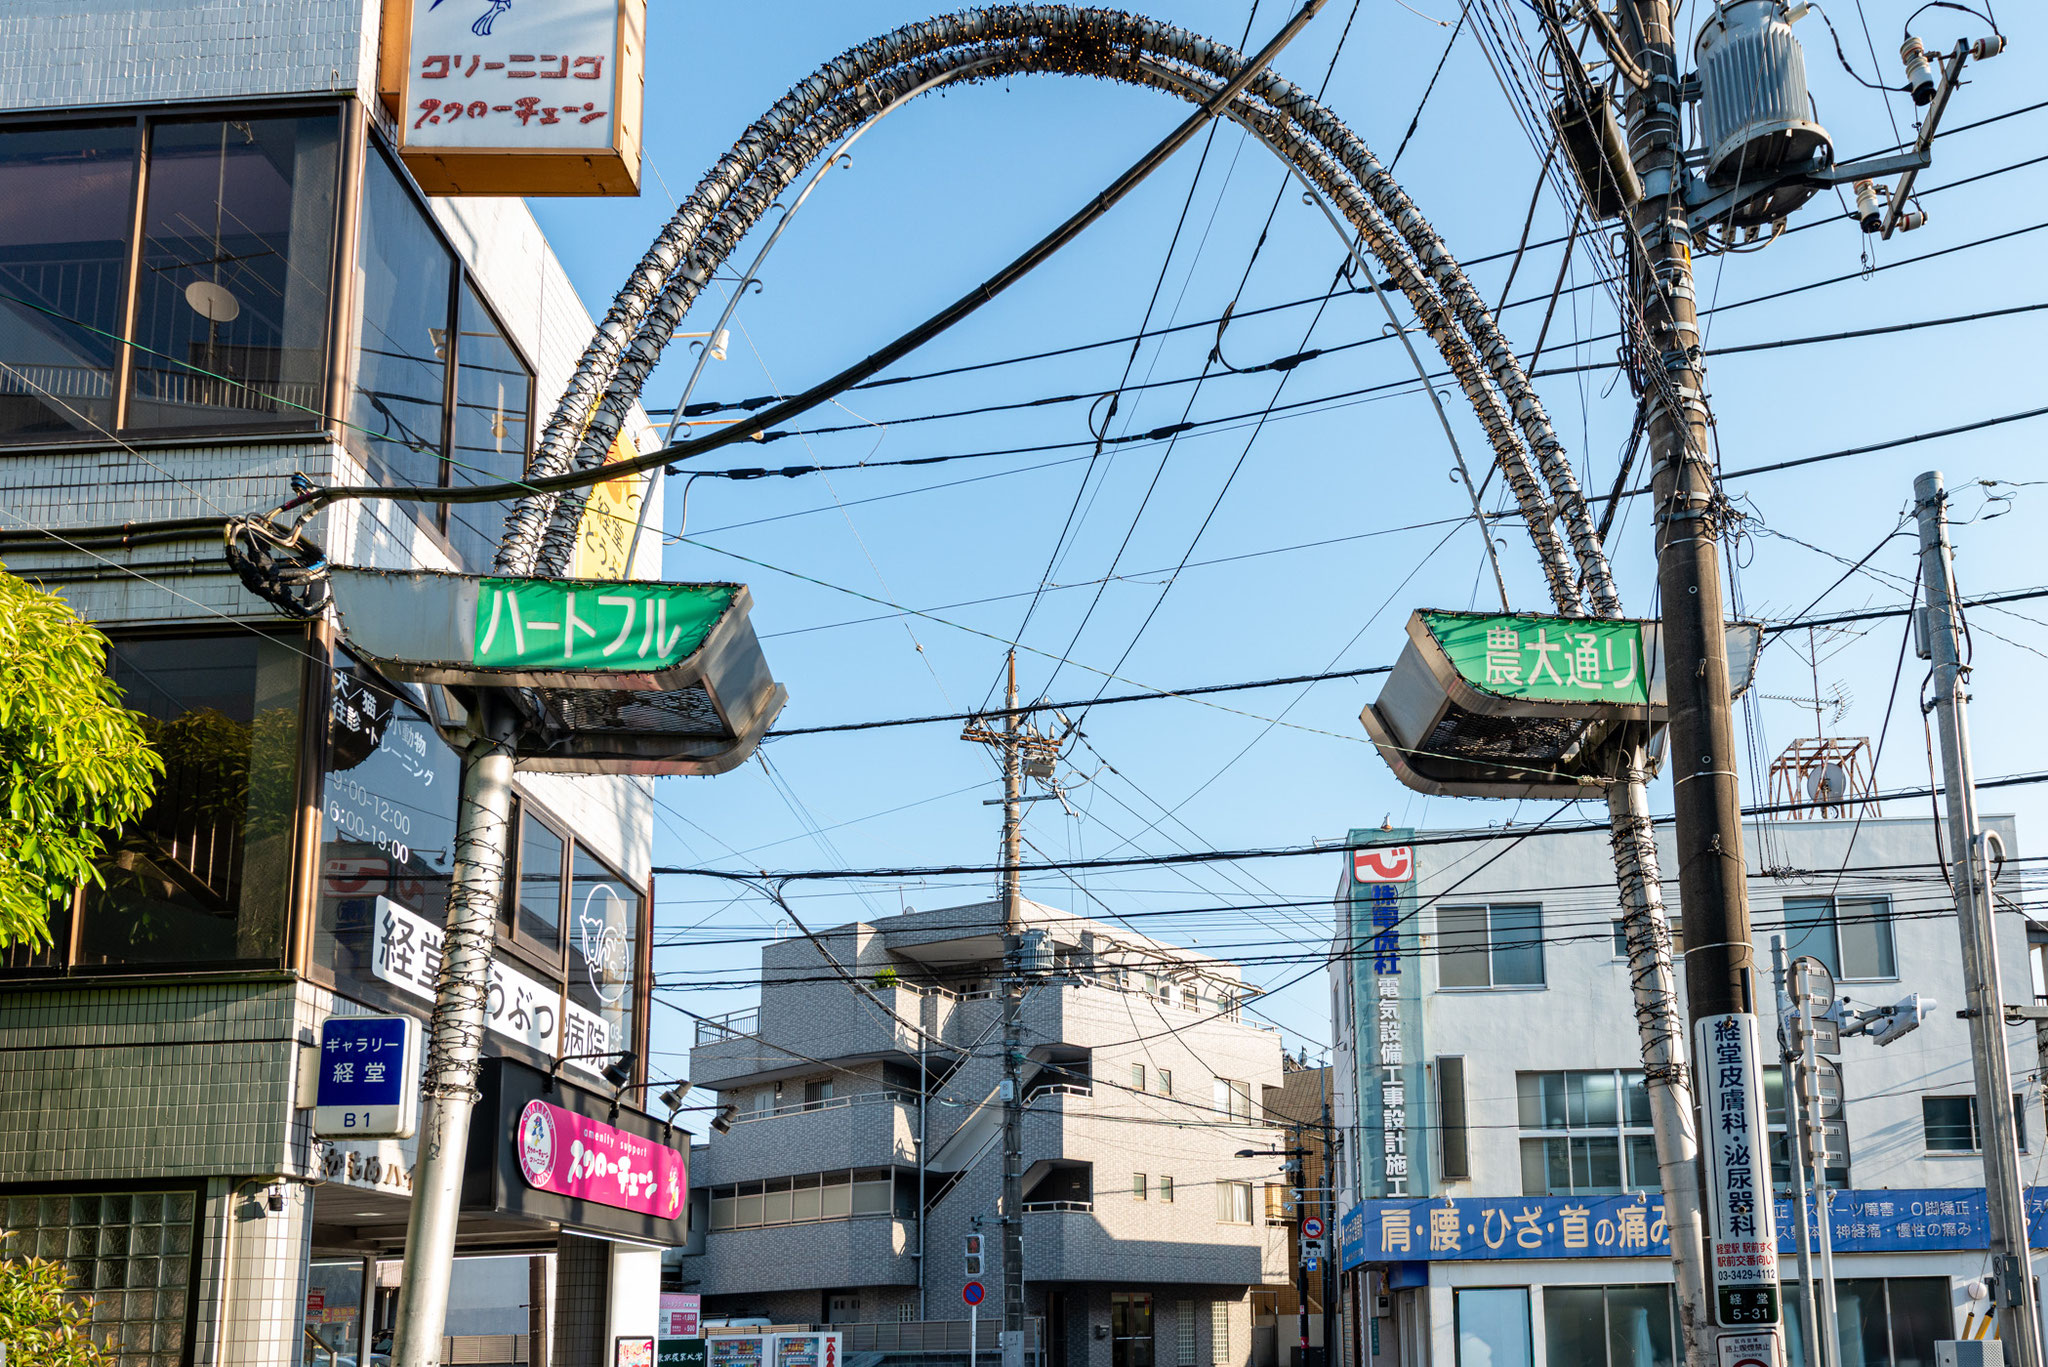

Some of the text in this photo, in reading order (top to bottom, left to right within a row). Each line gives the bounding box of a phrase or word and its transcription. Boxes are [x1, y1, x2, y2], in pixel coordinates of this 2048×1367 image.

[422, 54, 605, 79] クリーニング
[480, 590, 682, 659] ハートフル
[1485, 625, 1637, 690] 農大通り
[380, 910, 604, 1070] 経堂うぶつ病院
[326, 1037, 399, 1053] ギャラリー
[332, 1062, 386, 1083] 経堂
[1378, 977, 1409, 1198] 電気設備工事設計施工
[343, 1112, 371, 1128] B1
[1714, 1019, 1756, 1237] 経堂皮膚科・泌尿器科
[583, 1129, 647, 1157] amenity support
[1380, 1204, 1670, 1252] 肩・腰・ひざ・首の痛み
[1717, 1255, 1774, 1267] 駅前交番向い
[1718, 1269, 1775, 1281] 03-3429-4112
[1733, 1308, 1768, 1320] 5-31
